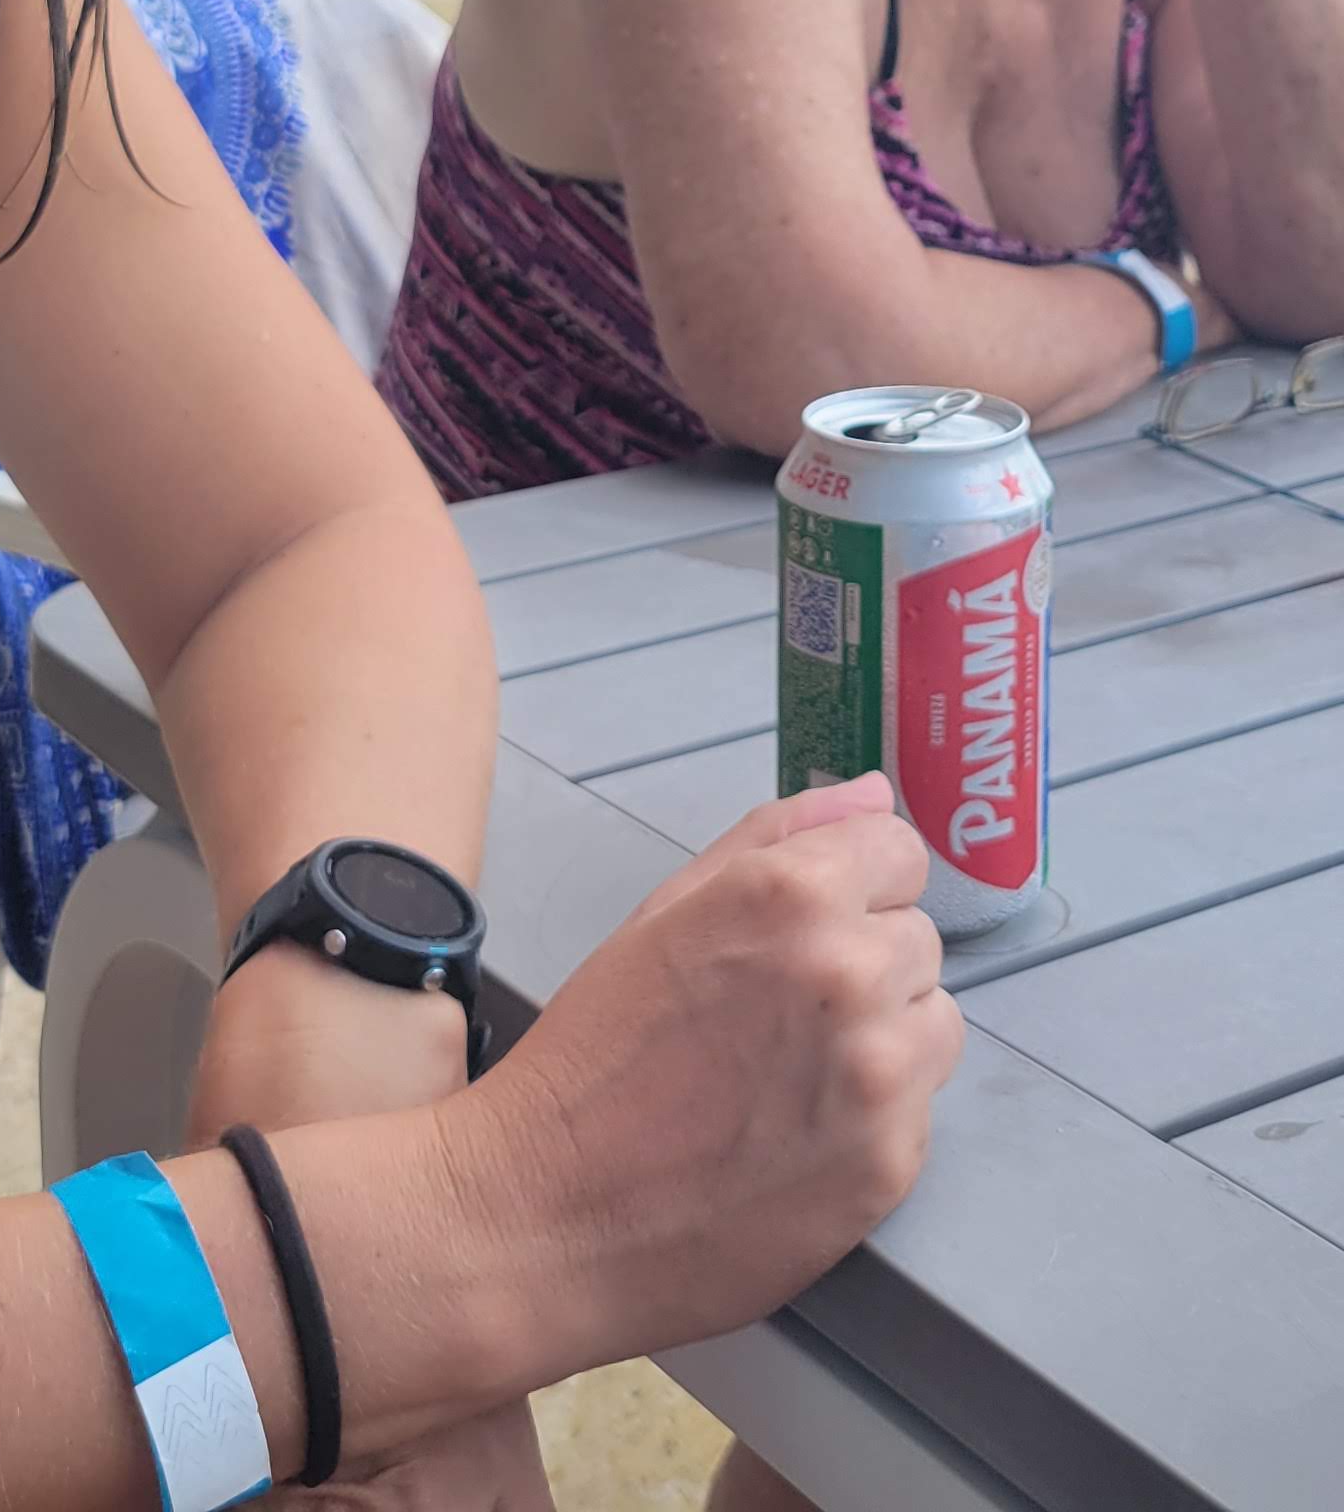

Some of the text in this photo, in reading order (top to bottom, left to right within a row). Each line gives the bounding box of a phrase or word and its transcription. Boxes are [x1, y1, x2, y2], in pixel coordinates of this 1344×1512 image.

[787, 459, 852, 501] LAGER
[928, 691, 946, 746] CERVEZA
[947, 570, 1020, 864] PANAMÁ
